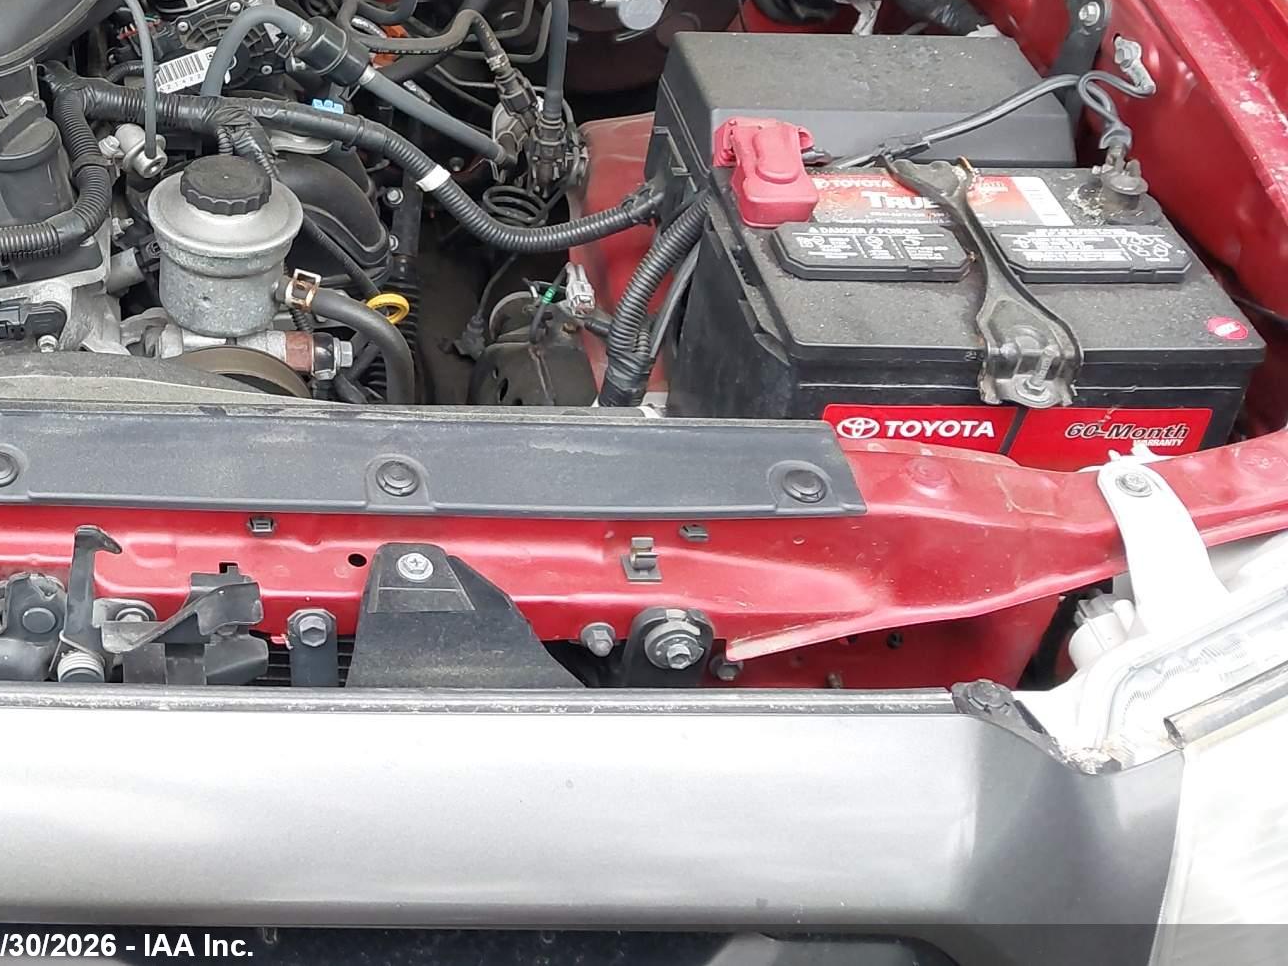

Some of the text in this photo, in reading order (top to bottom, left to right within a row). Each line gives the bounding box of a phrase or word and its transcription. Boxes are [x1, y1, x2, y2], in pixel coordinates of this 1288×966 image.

[818, 227, 867, 235] DANGER
[884, 420, 995, 438] TOYOTA
[1064, 422, 1190, 440] 60-Month
